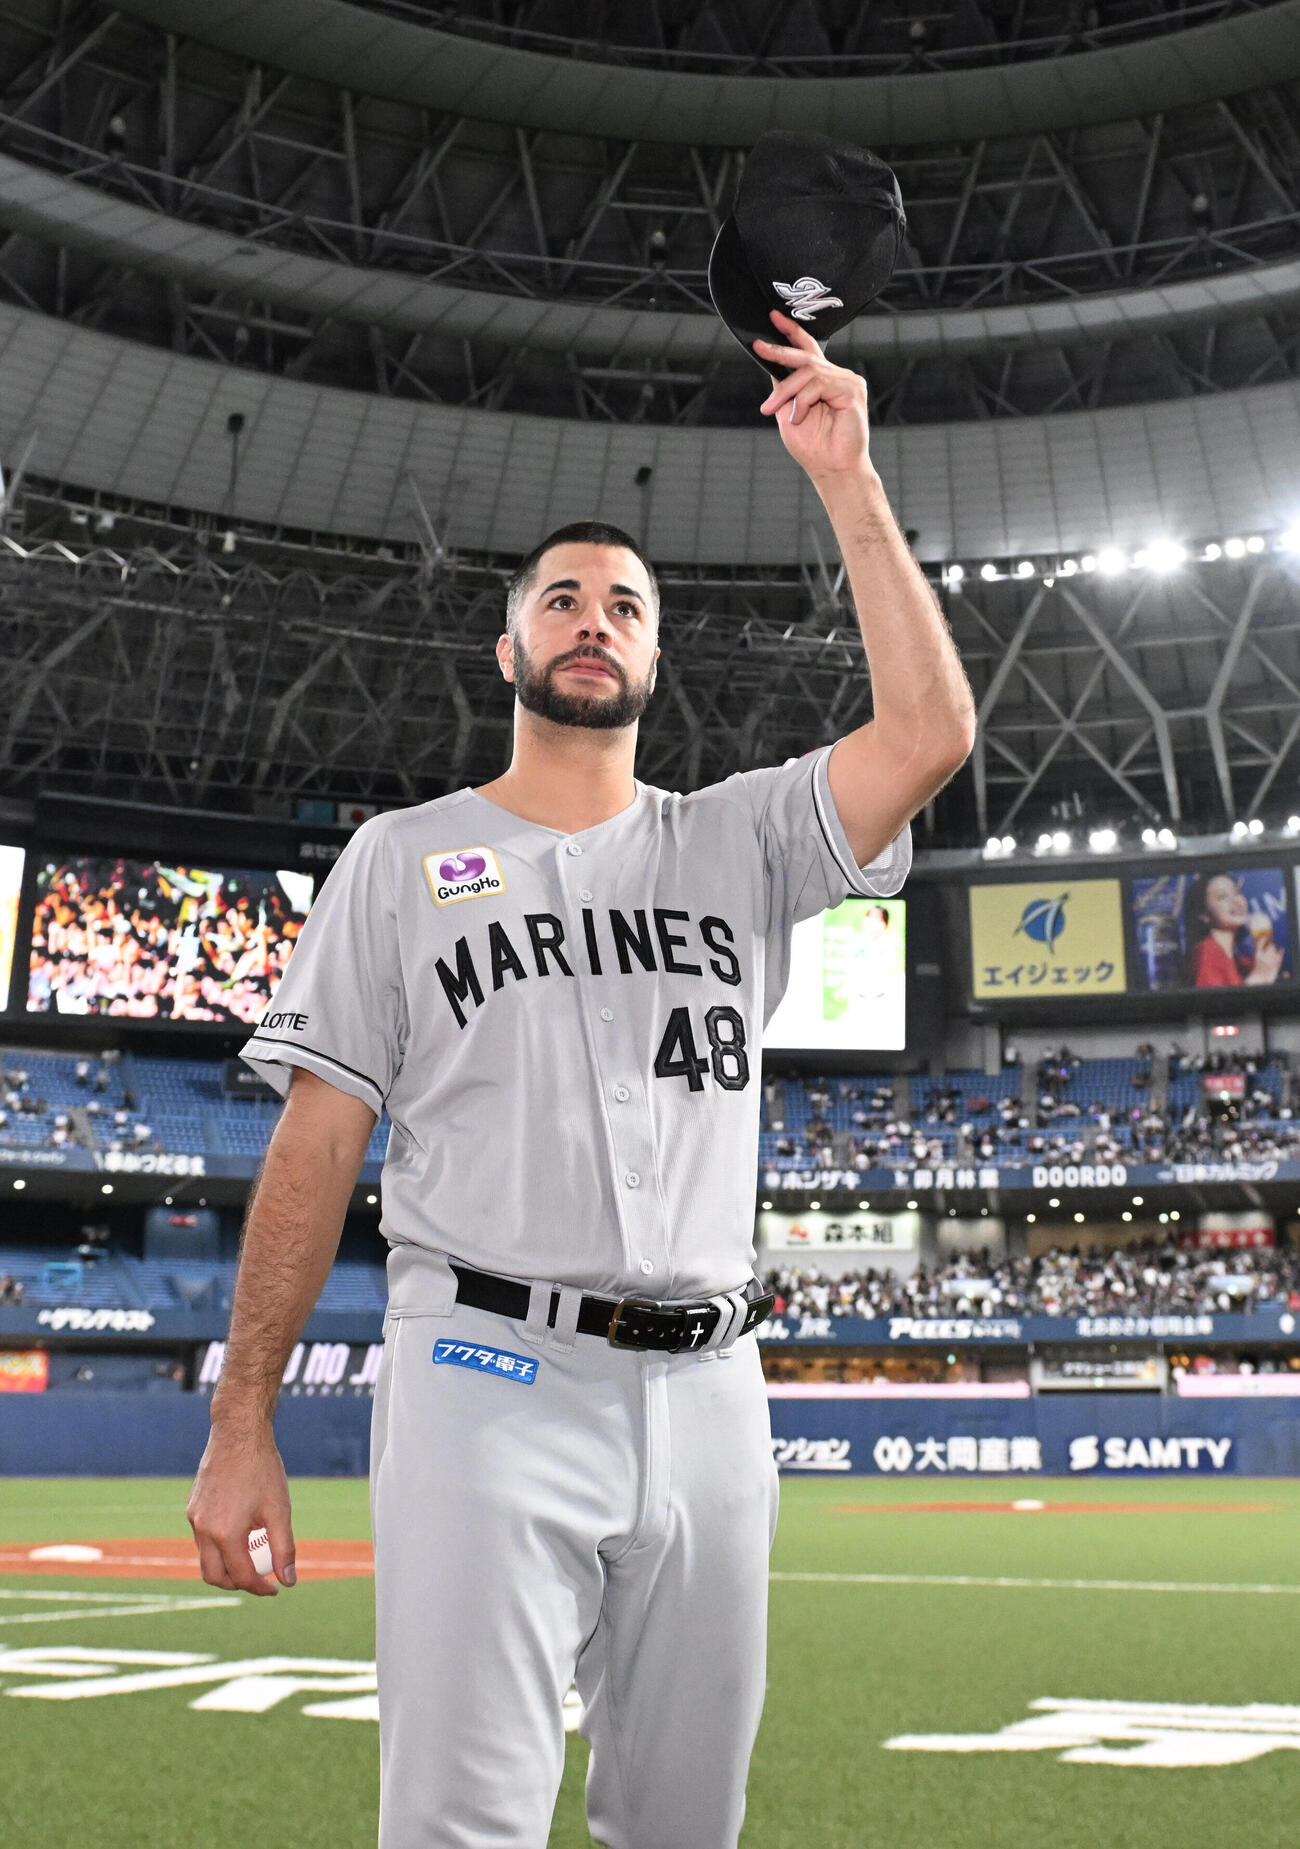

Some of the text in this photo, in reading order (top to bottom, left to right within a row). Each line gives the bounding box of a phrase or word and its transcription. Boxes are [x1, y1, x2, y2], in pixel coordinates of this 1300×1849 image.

[437, 877, 500, 899] GungHo
[434, 908, 742, 1030] MARINES
[983, 961, 1115, 986] エイジェック
[260, 1012, 309, 1031] LOTTE
[654, 1006, 750, 1092] 48
[1032, 1165, 1127, 1188] DOORDO
[437, 1343, 534, 1376] フクダ電子
[1103, 1437, 1232, 1468] SAMTY
